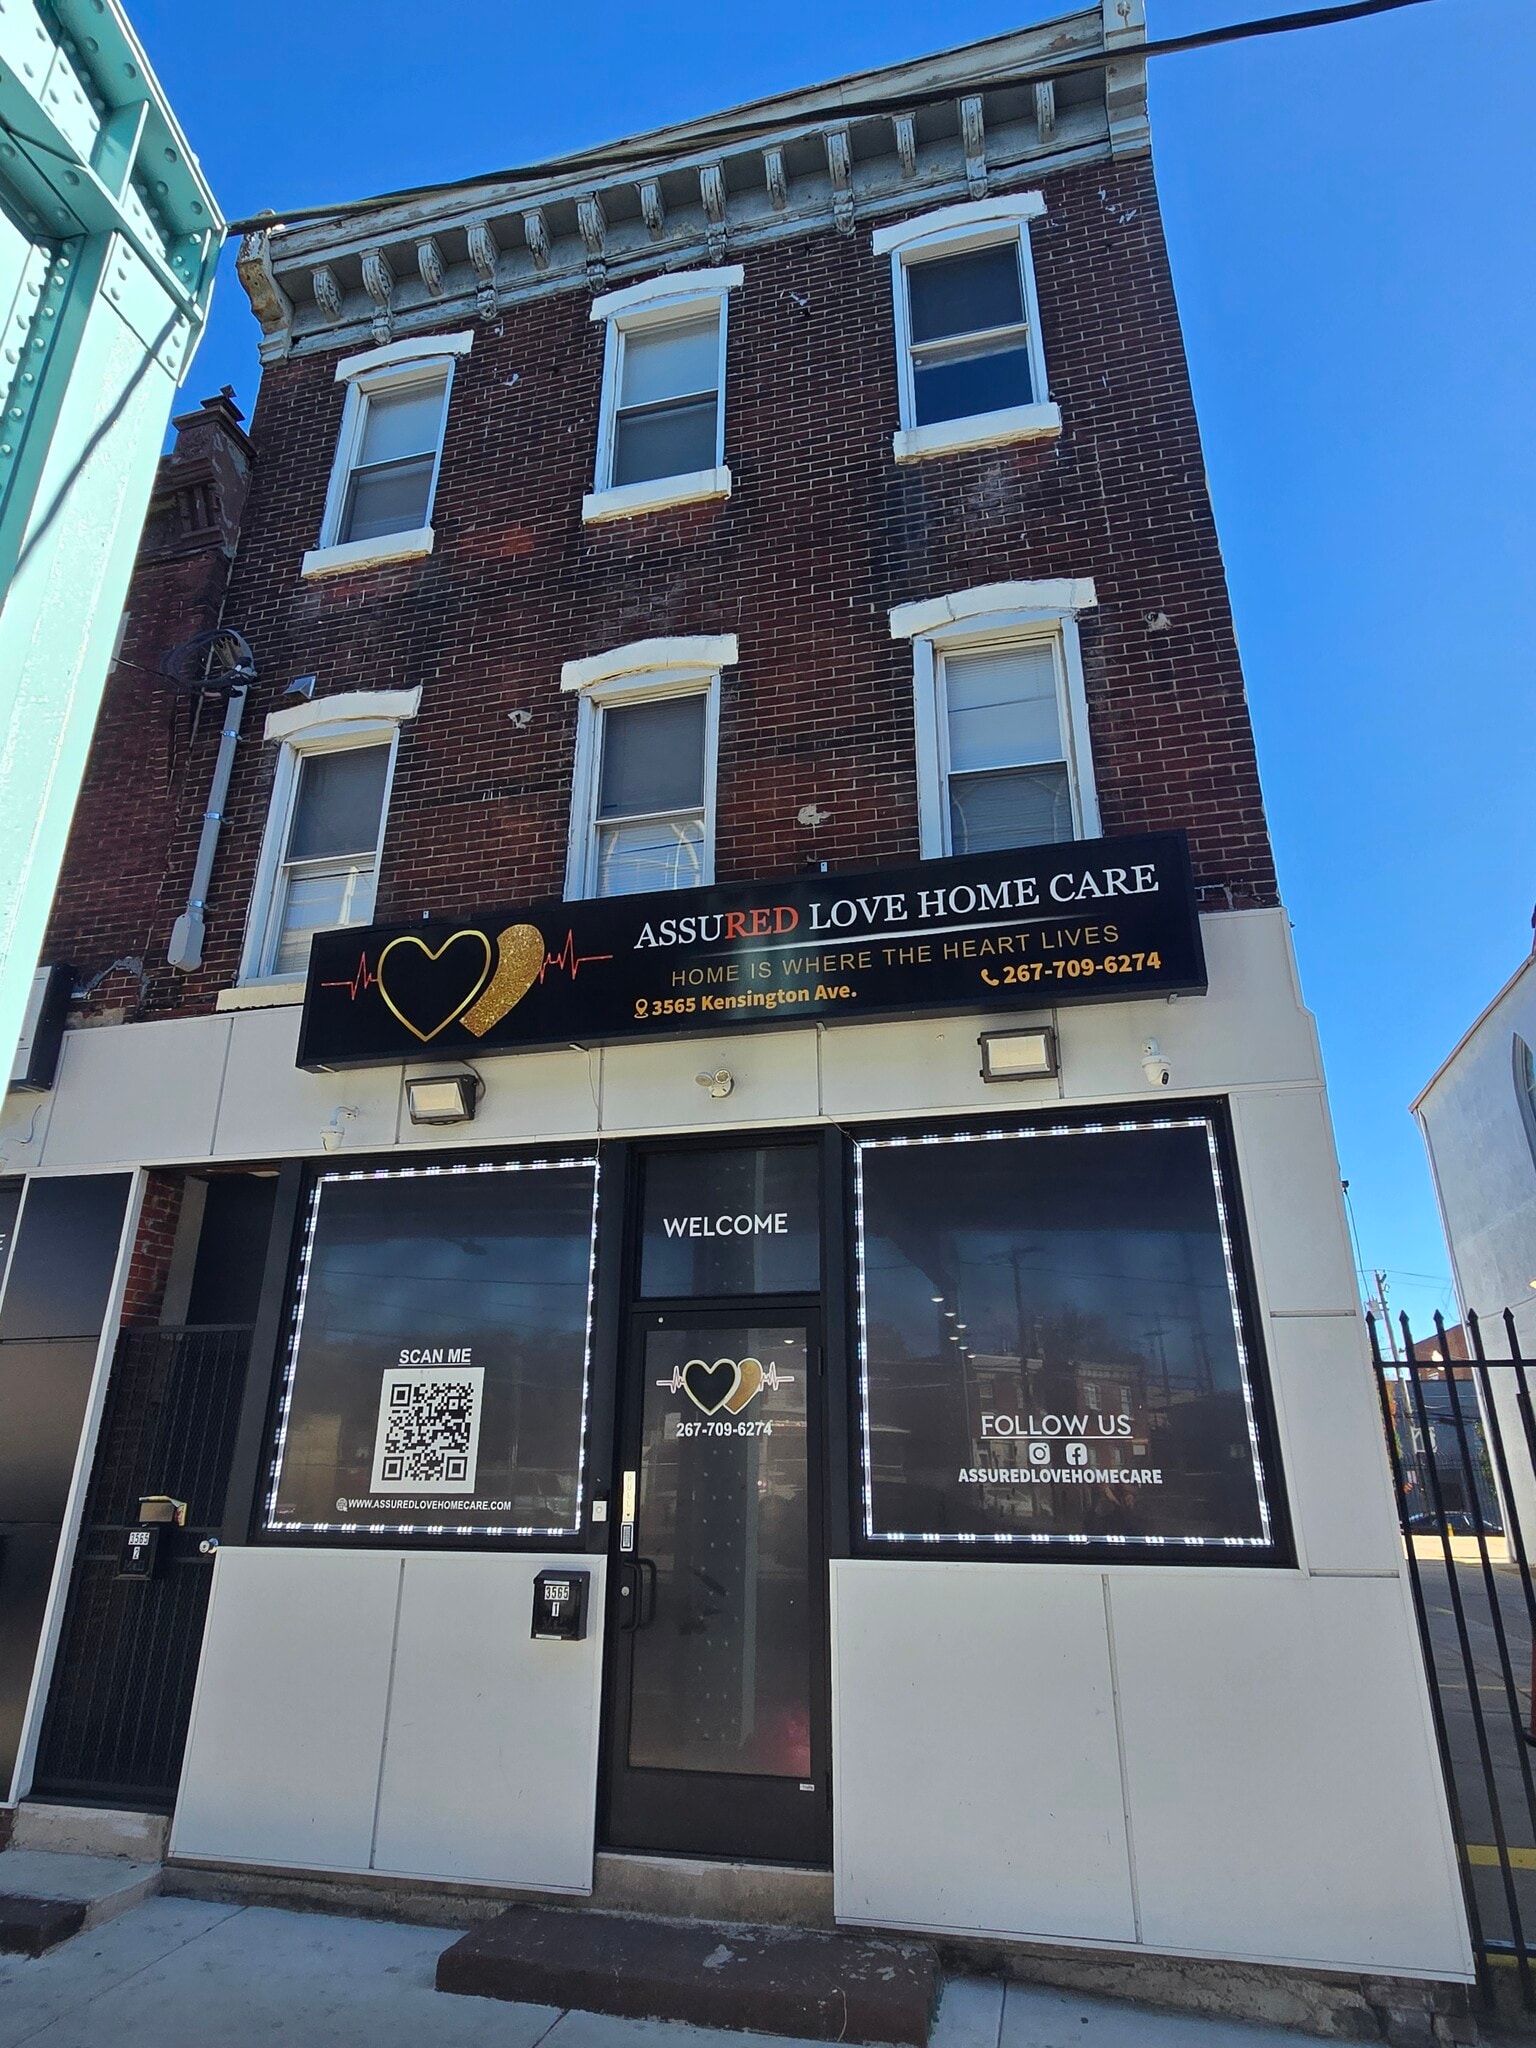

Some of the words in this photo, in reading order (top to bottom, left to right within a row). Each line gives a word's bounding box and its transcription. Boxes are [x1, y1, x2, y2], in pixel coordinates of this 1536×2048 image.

[634, 906, 800, 949] ASSURED
[808, 893, 908, 932] LOVE
[917, 877, 1040, 920] HOME
[1049, 863, 1160, 903] CARE
[671, 964, 740, 987] HOME
[750, 962, 772, 980] IS
[782, 952, 872, 977] WHERE
[882, 945, 932, 965] THE
[943, 934, 1030, 960] HEART
[1041, 925, 1119, 949] LIVES
[1003, 951, 1161, 984] 267-709-6274
[651, 998, 696, 1016] 3565
[701, 988, 810, 1011] Kensington
[814, 984, 858, 1002] Ave.
[663, 1213, 788, 1238] WELCOME
[398, 1348, 444, 1364] SCAN
[448, 1348, 472, 1363] ME
[676, 1421, 773, 1438] 267-709-6274
[981, 1414, 1089, 1435] FOLLOW
[1097, 1414, 1132, 1435] US
[958, 1468, 1163, 1484] ASSUREDLOVEHOMECARE
[348, 1498, 512, 1511] WWW.ASSUREDLOVEHOMECARE.COM
[130, 1532, 149, 1544] 3565
[545, 1586, 569, 1599] 3565
